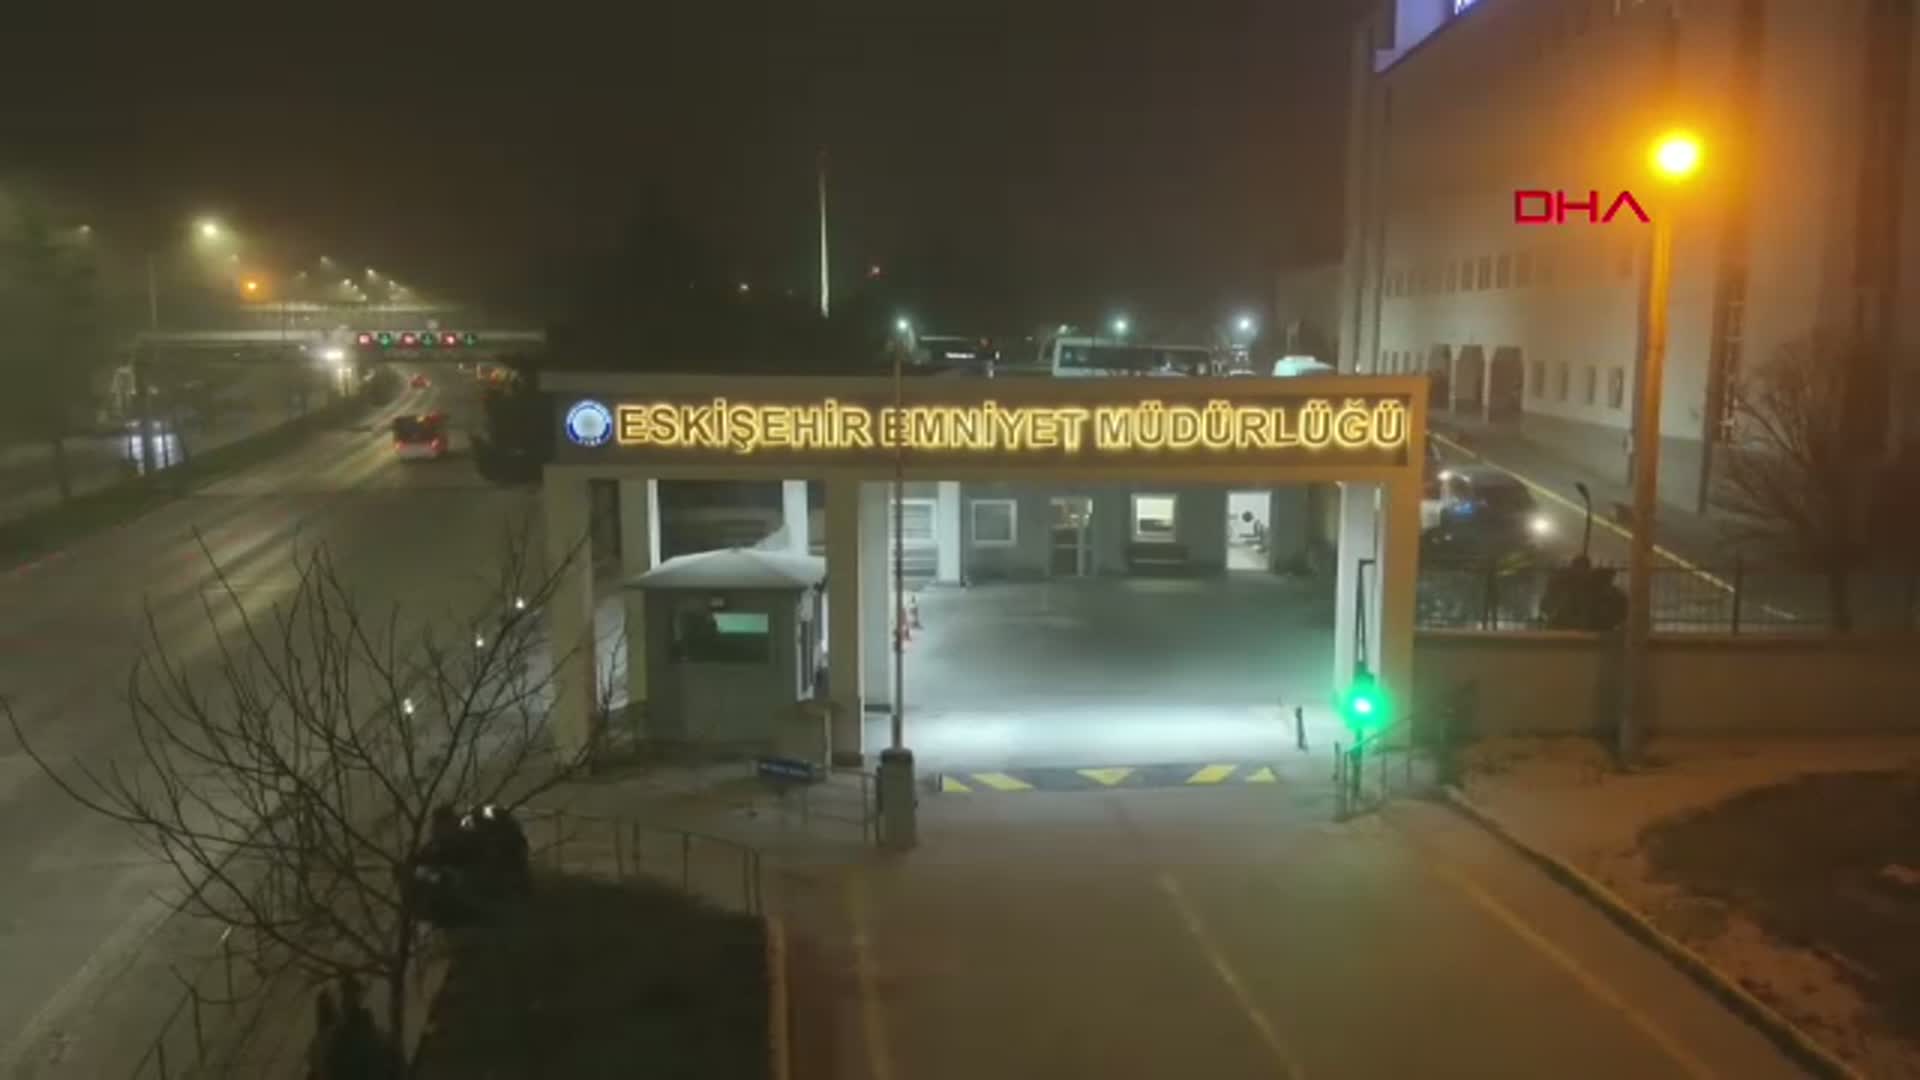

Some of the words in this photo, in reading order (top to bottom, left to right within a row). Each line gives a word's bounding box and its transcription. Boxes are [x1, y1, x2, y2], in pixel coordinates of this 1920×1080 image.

[616, 397, 874, 454] ESKİŞEHİR
[880, 400, 1089, 450] EMNİYET
[1095, 398, 1406, 449] MÜDÜRLÜĞÜ
